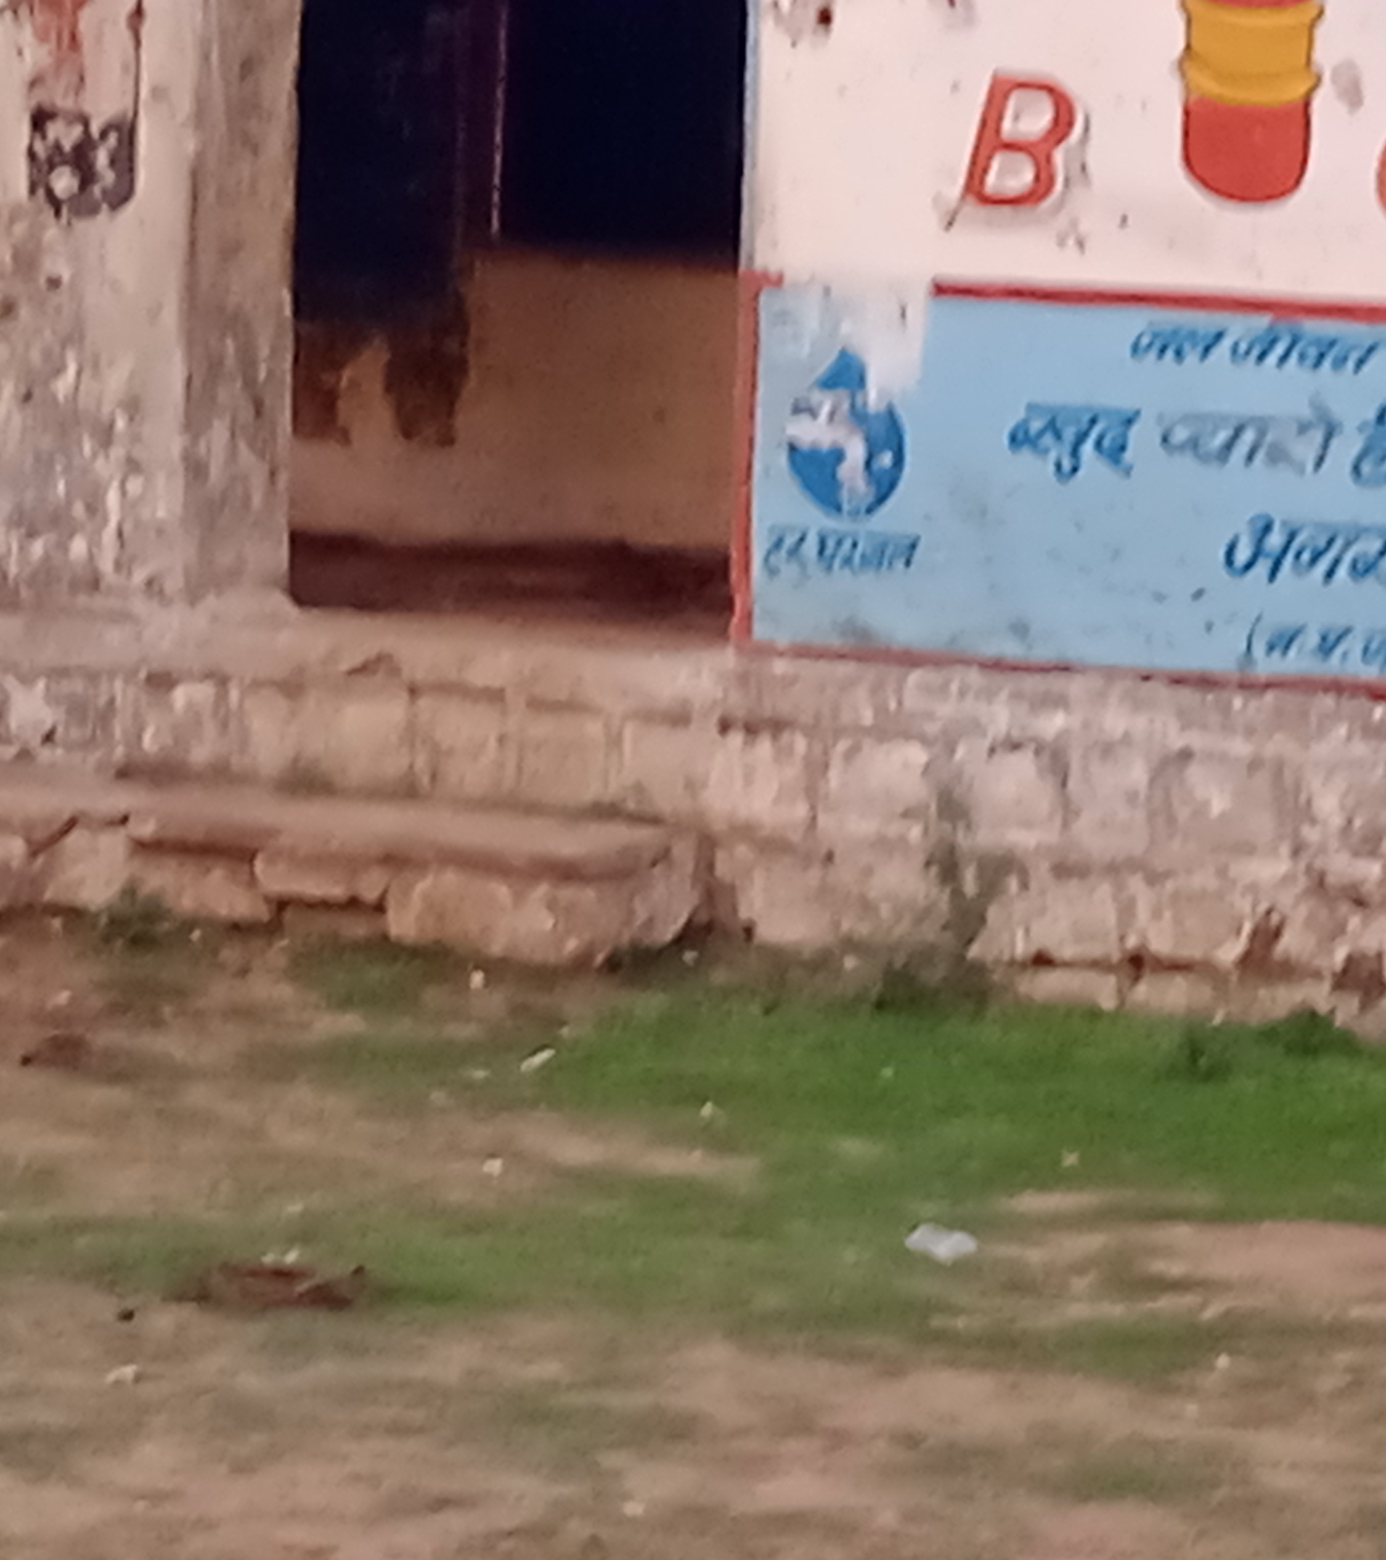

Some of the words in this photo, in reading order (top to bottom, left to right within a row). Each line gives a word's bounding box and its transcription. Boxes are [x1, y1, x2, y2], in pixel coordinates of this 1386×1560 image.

[955, 70, 1080, 215] B
[1130, 321, 1228, 366] जल
[1007, 402, 1141, 484] खुद
